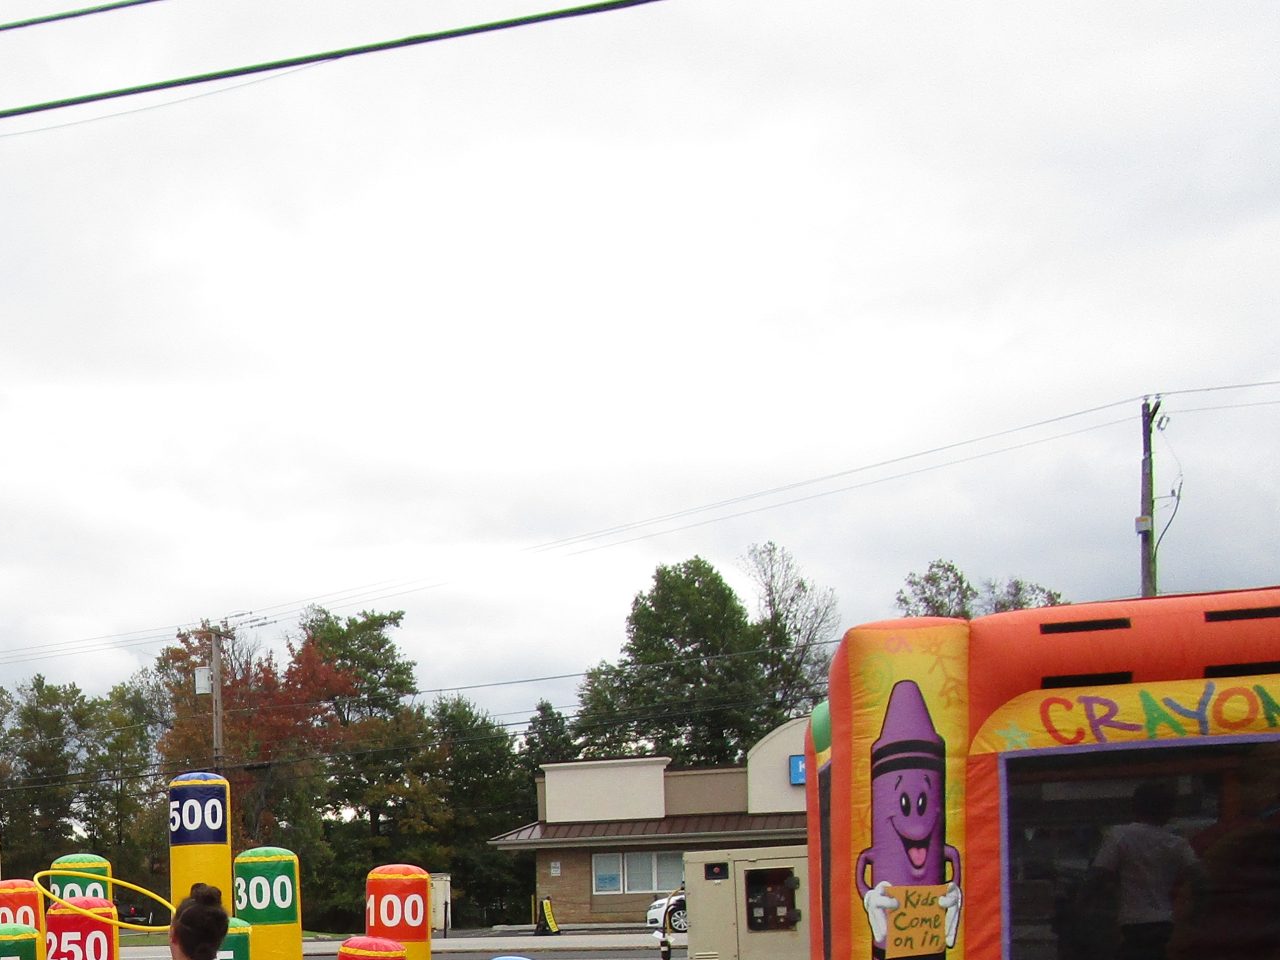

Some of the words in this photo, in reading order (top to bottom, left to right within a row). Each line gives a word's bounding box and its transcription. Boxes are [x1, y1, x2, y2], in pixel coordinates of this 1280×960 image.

[170, 798, 223, 832] 500
[235, 875, 293, 911] 300
[904, 889, 937, 909] Kids
[367, 893, 424, 927] 100
[893, 911, 942, 931] Come
[894, 936, 914, 949] on
[921, 930, 940, 947] in
